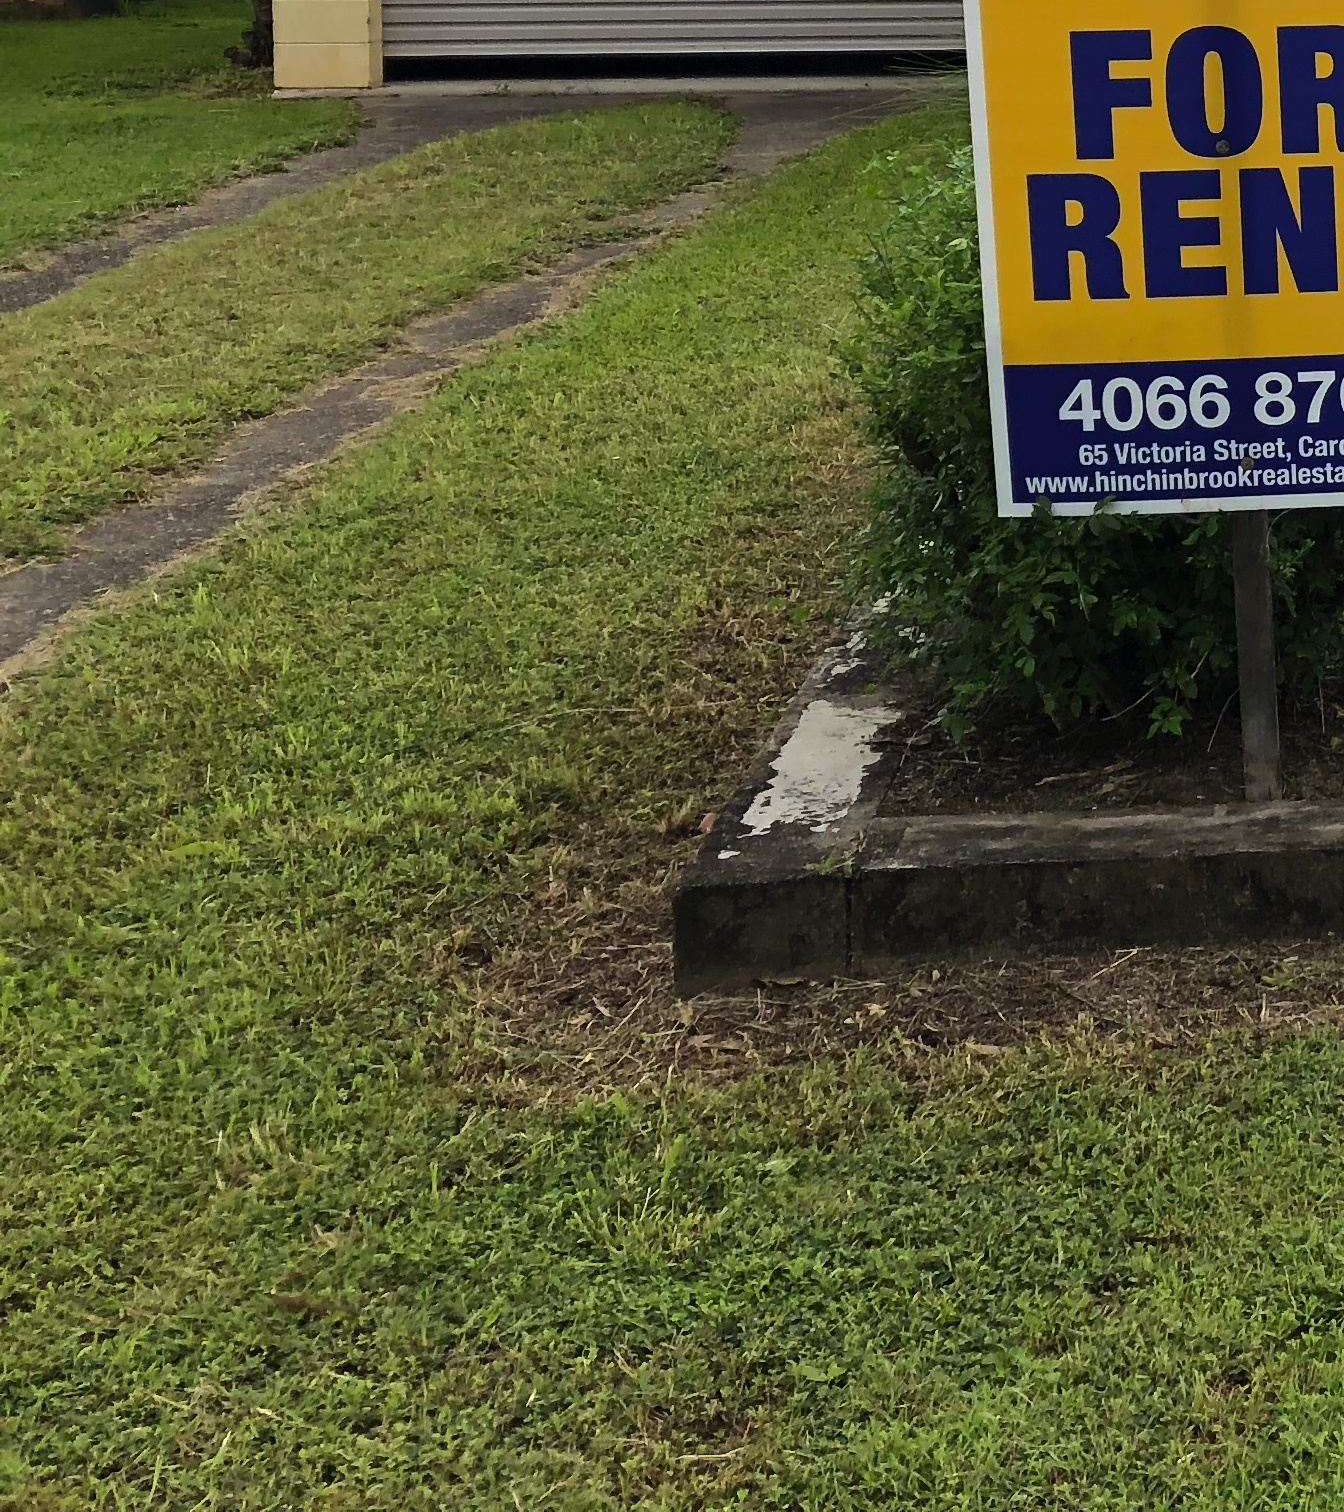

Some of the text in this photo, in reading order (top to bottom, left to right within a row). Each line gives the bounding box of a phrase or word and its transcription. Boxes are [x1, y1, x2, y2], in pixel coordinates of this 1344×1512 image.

[1058, 374, 1230, 432] 4066
[1078, 443, 1106, 466] 65
[1114, 439, 1206, 465] Victoria
[1213, 437, 1292, 462] Street,
